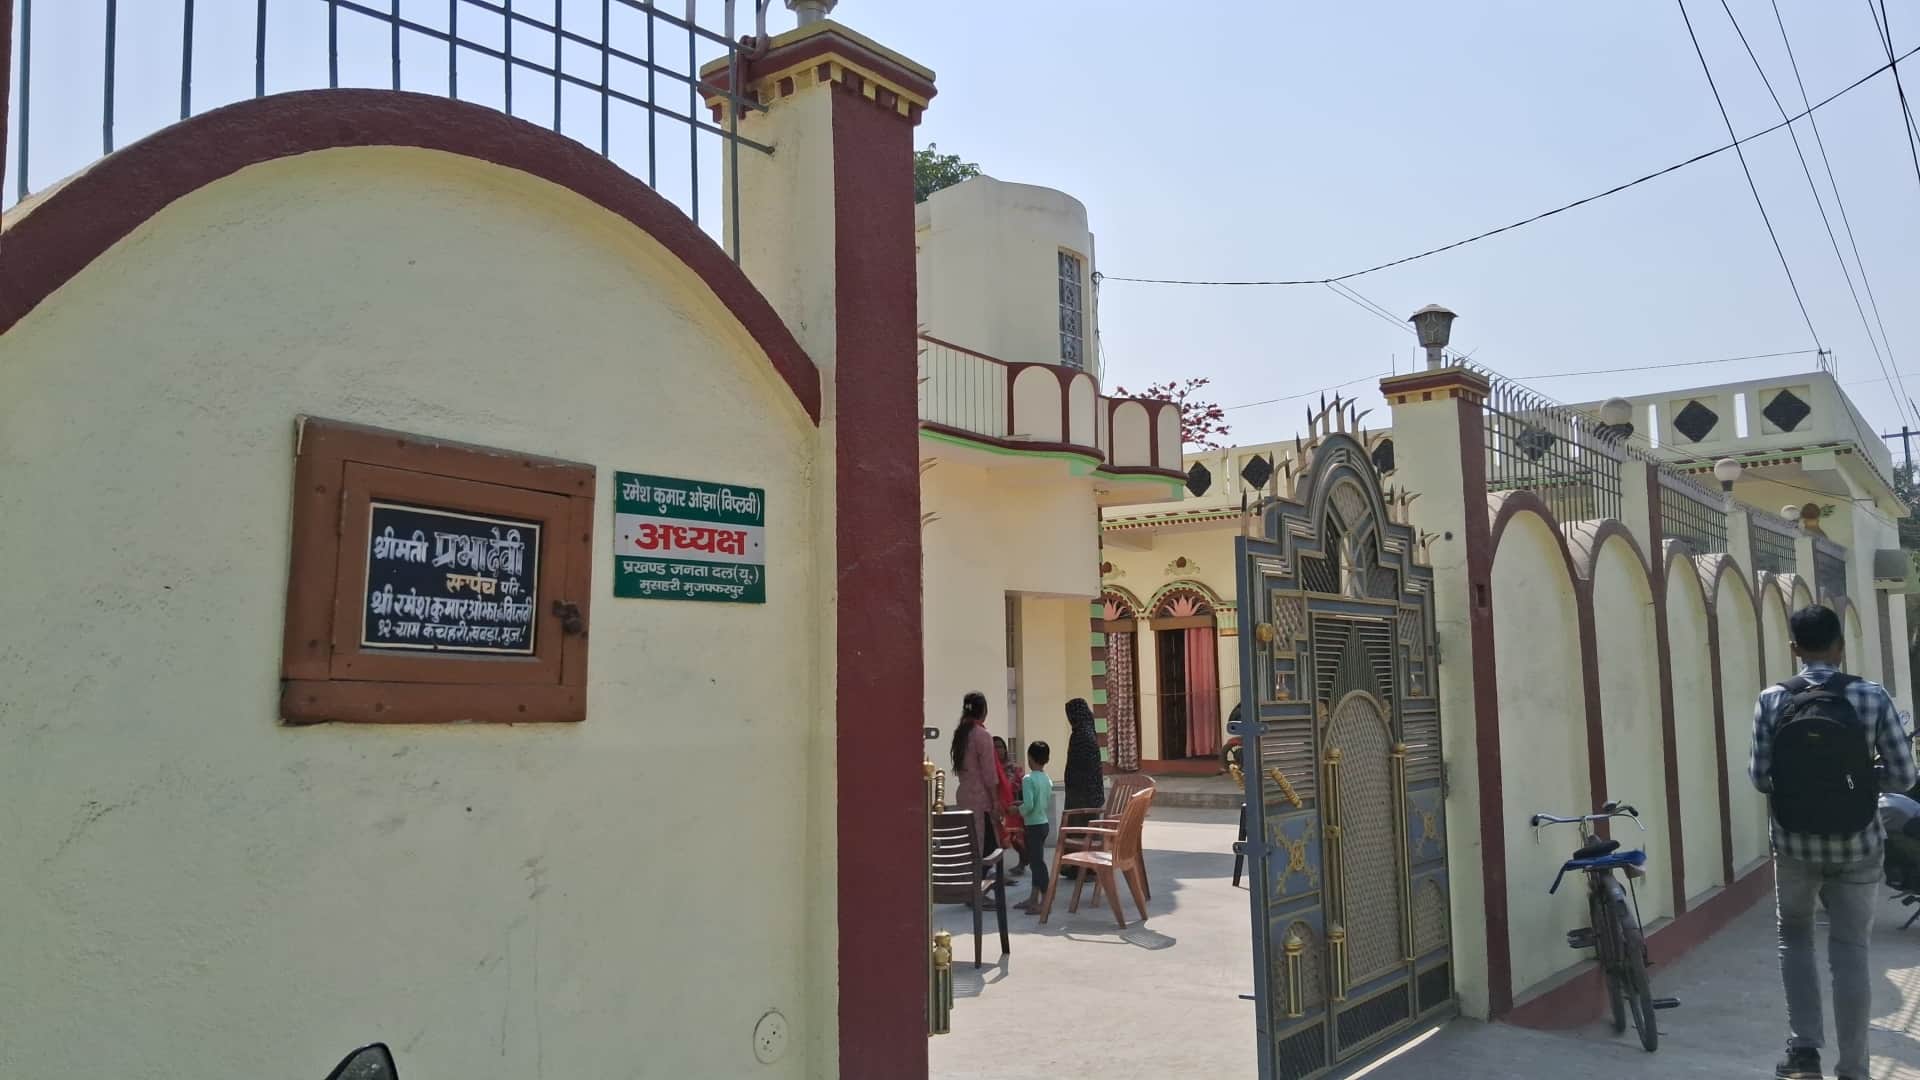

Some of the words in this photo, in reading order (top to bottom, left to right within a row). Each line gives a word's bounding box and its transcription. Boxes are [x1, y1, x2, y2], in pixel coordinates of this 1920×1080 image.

[622, 478, 651, 503] रमेश
[653, 487, 687, 514] कुमार
[374, 525, 429, 563] श्रीमती
[635, 523, 747, 555] अध्यक्ष
[623, 560, 666, 576] प्रखण्ड
[669, 563, 709, 577] जनता
[370, 583, 393, 616] श्री
[639, 577, 681, 595] मुसहरी
